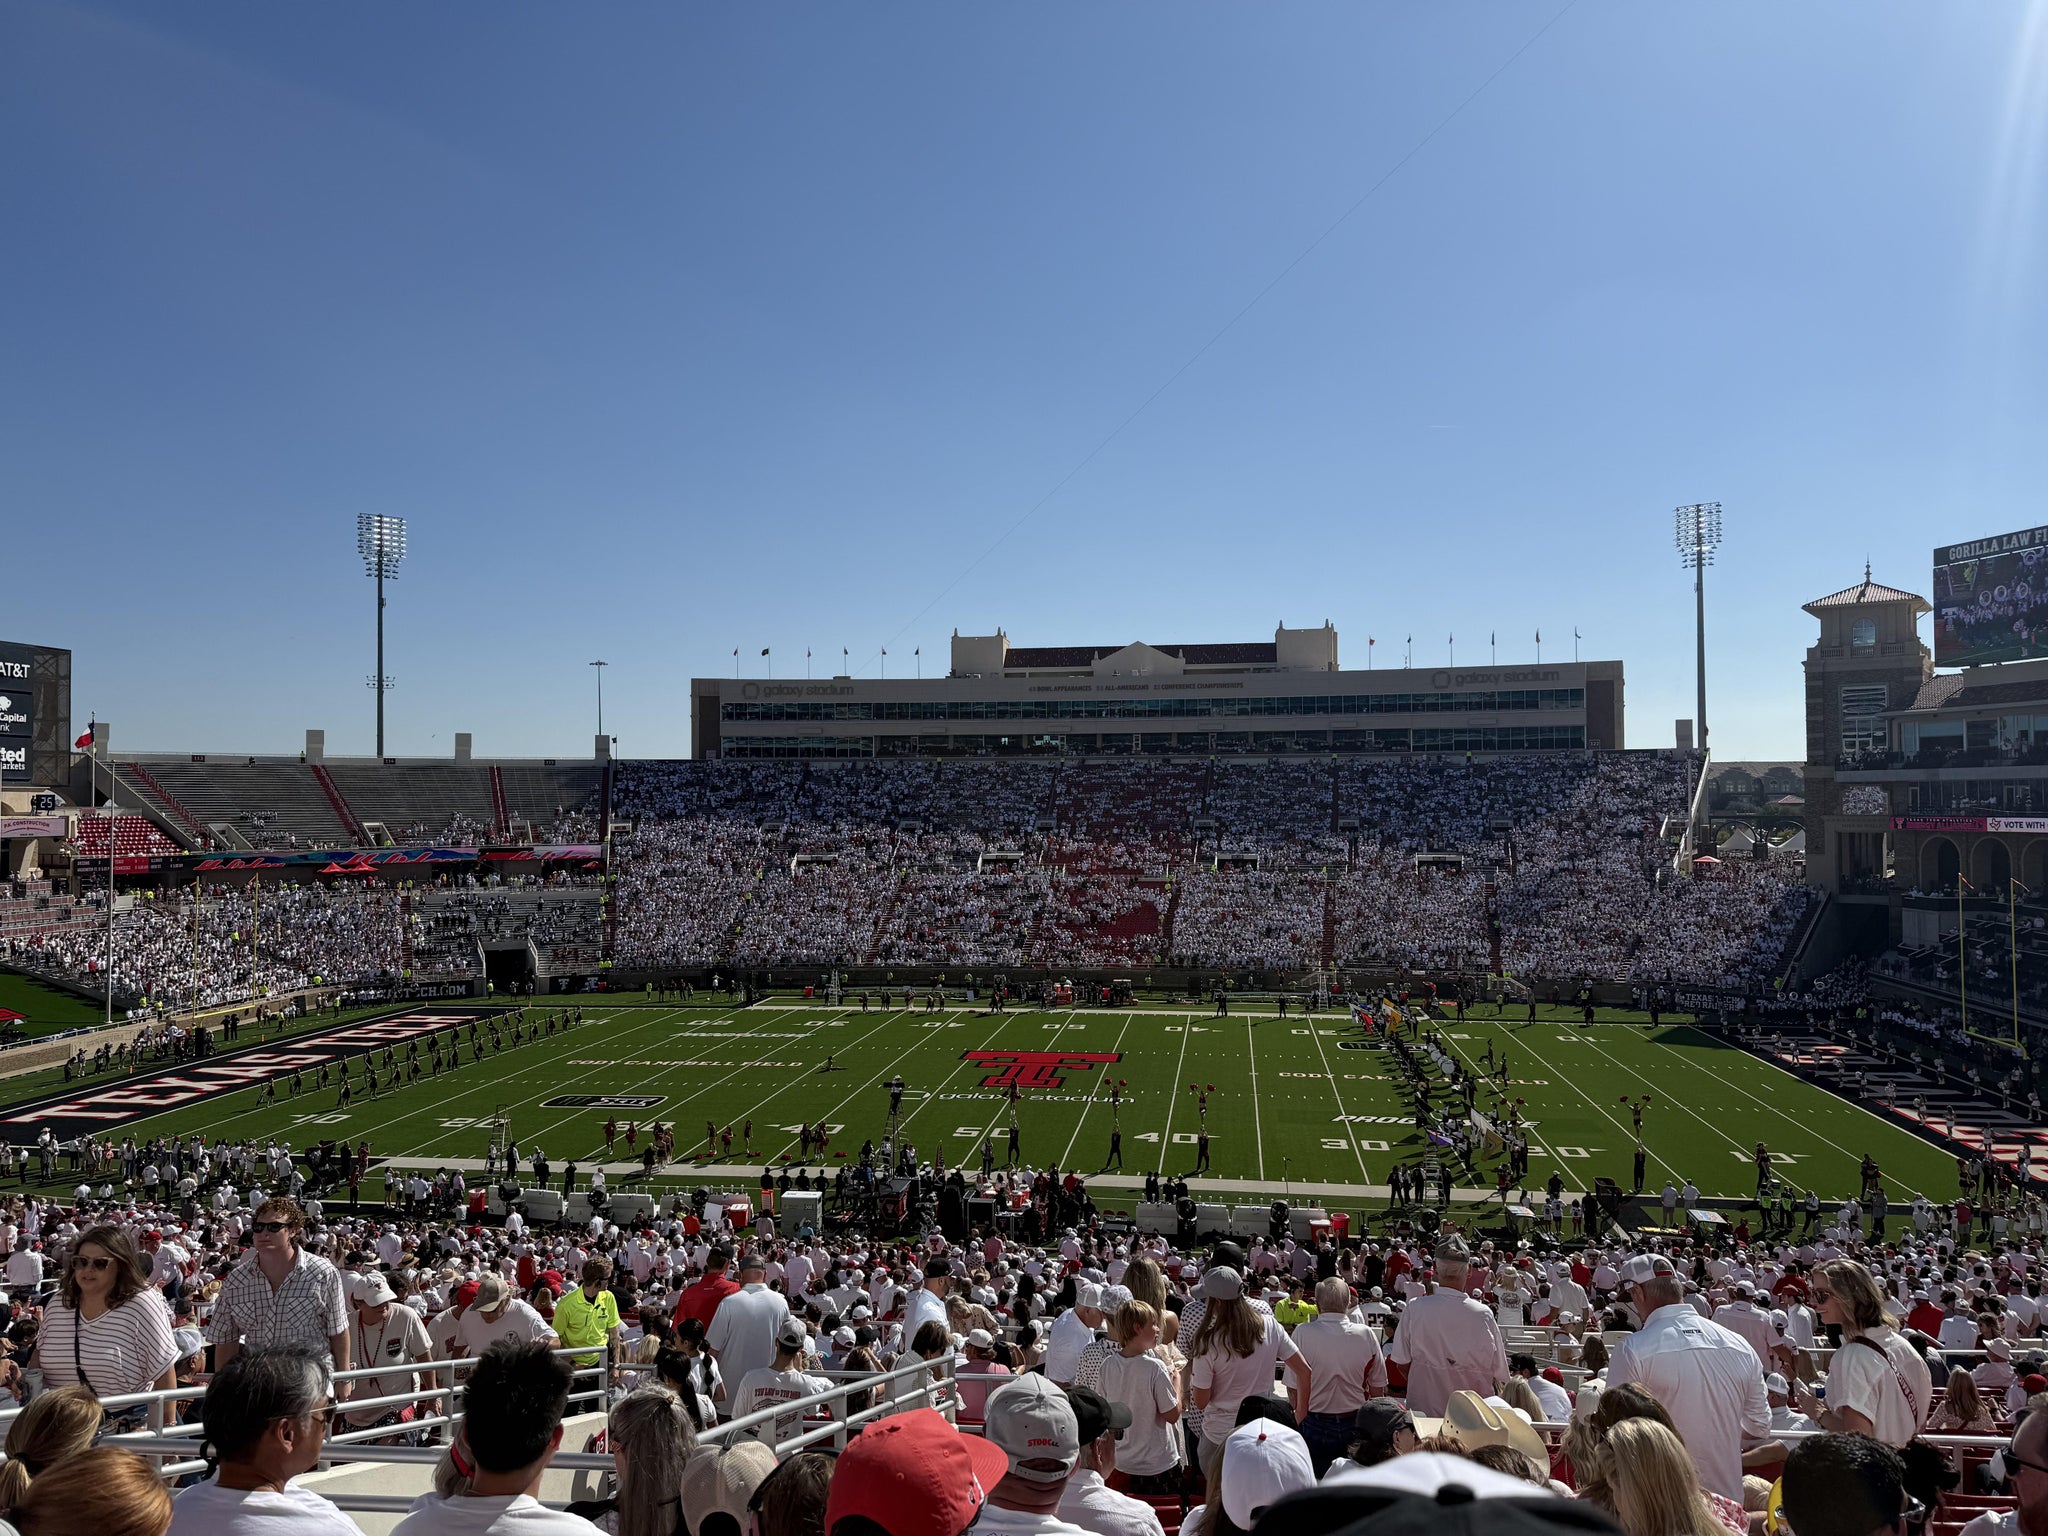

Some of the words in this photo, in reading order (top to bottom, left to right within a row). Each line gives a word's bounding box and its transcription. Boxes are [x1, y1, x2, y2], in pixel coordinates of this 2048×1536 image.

[1949, 538, 2000, 560] GORILLA
[2002, 531, 2031, 550] LAW
[0, 661, 31, 678] AT&T
[1455, 671, 1501, 687] galaxy
[1504, 669, 1559, 682] stadium
[763, 683, 804, 698] galaxy
[806, 683, 854, 696] stadium
[0, 761, 26, 770] arkets
[40, 797, 53, 808] 25
[12, 820, 50, 828] CONSTRUCTION
[2004, 820, 2024, 829] VOTE
[2025, 820, 2045, 829] WITH
[1685, 993, 1713, 1001] TEXAS
[1, 1053, 336, 1124] TEXAS
[288, 1015, 481, 1049] TECH
[939, 1092, 1013, 1103] galax
[953, 1126, 1010, 1138] 50
[1133, 1131, 1199, 1144] 40
[1320, 1138, 1391, 1151] 30
